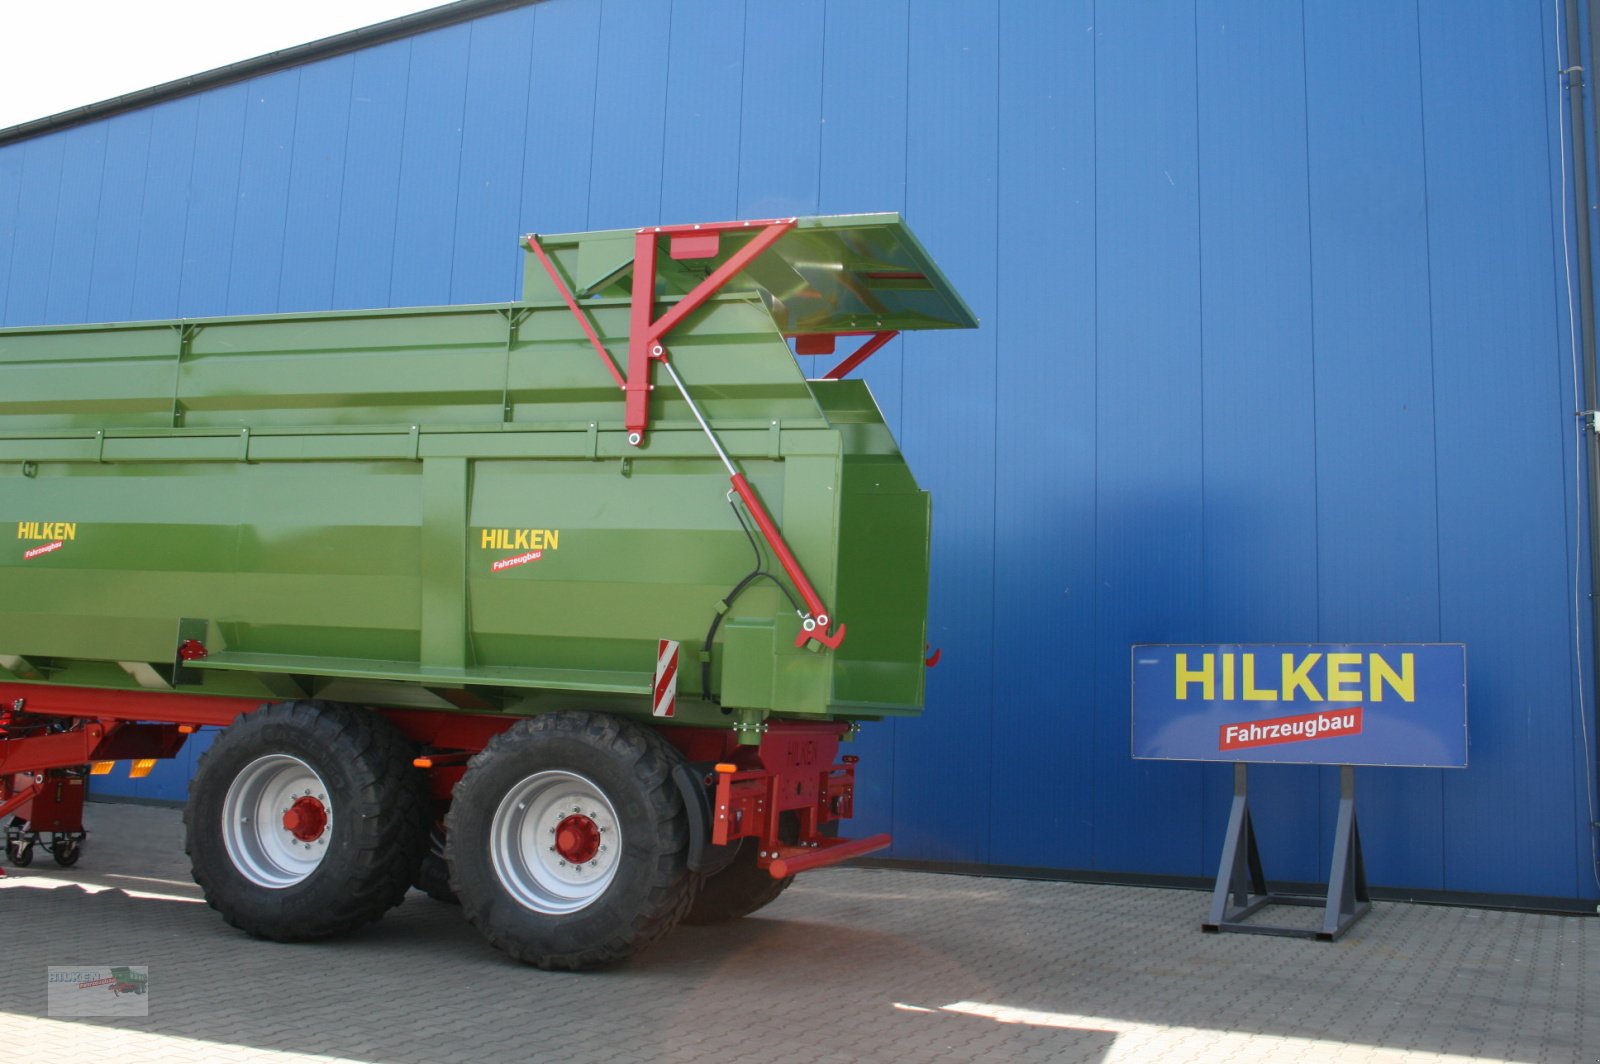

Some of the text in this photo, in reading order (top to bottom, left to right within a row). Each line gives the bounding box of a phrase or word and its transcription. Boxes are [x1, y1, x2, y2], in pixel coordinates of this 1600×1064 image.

[17, 521, 76, 540] HILKEN
[481, 529, 559, 550] HILKEN
[493, 551, 541, 570] Fahrzeugbau
[1175, 653, 1415, 702] HILKEN
[1225, 714, 1355, 743] Fahrzeugbau
